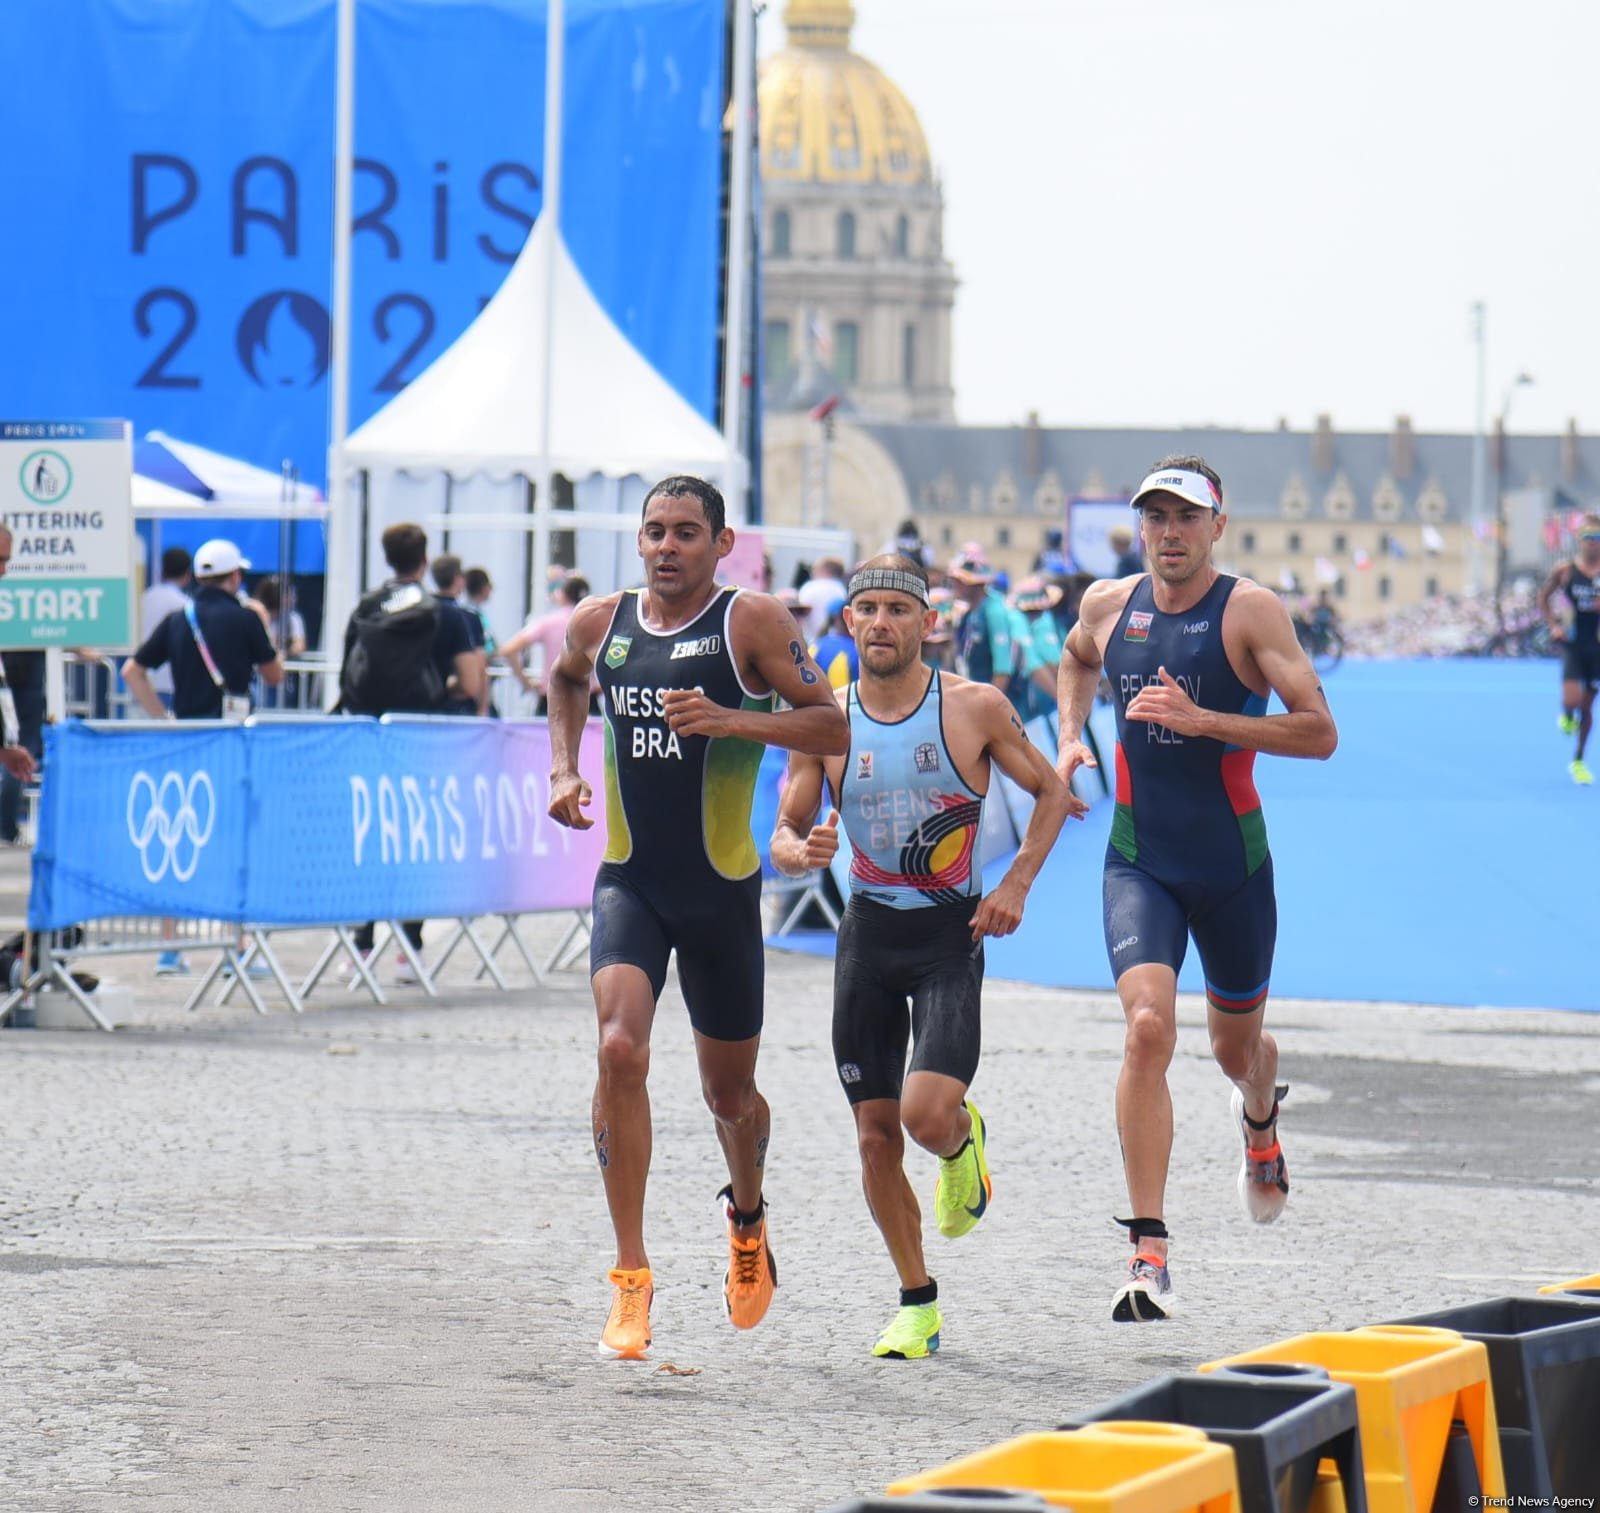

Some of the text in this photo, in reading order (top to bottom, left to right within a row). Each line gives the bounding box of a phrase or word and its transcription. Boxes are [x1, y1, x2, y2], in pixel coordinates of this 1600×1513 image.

[133, 287, 492, 394] 202
[2, 511, 104, 530] ITTERING
[19, 537, 76, 555] AREA
[0, 588, 104, 621] START
[787, 640, 819, 685] 26
[610, 685, 704, 718] MESS
[1120, 673, 1201, 704] PEOV
[632, 727, 683, 760] BRA
[860, 787, 946, 821] GEENS
[870, 820, 937, 850] BEL
